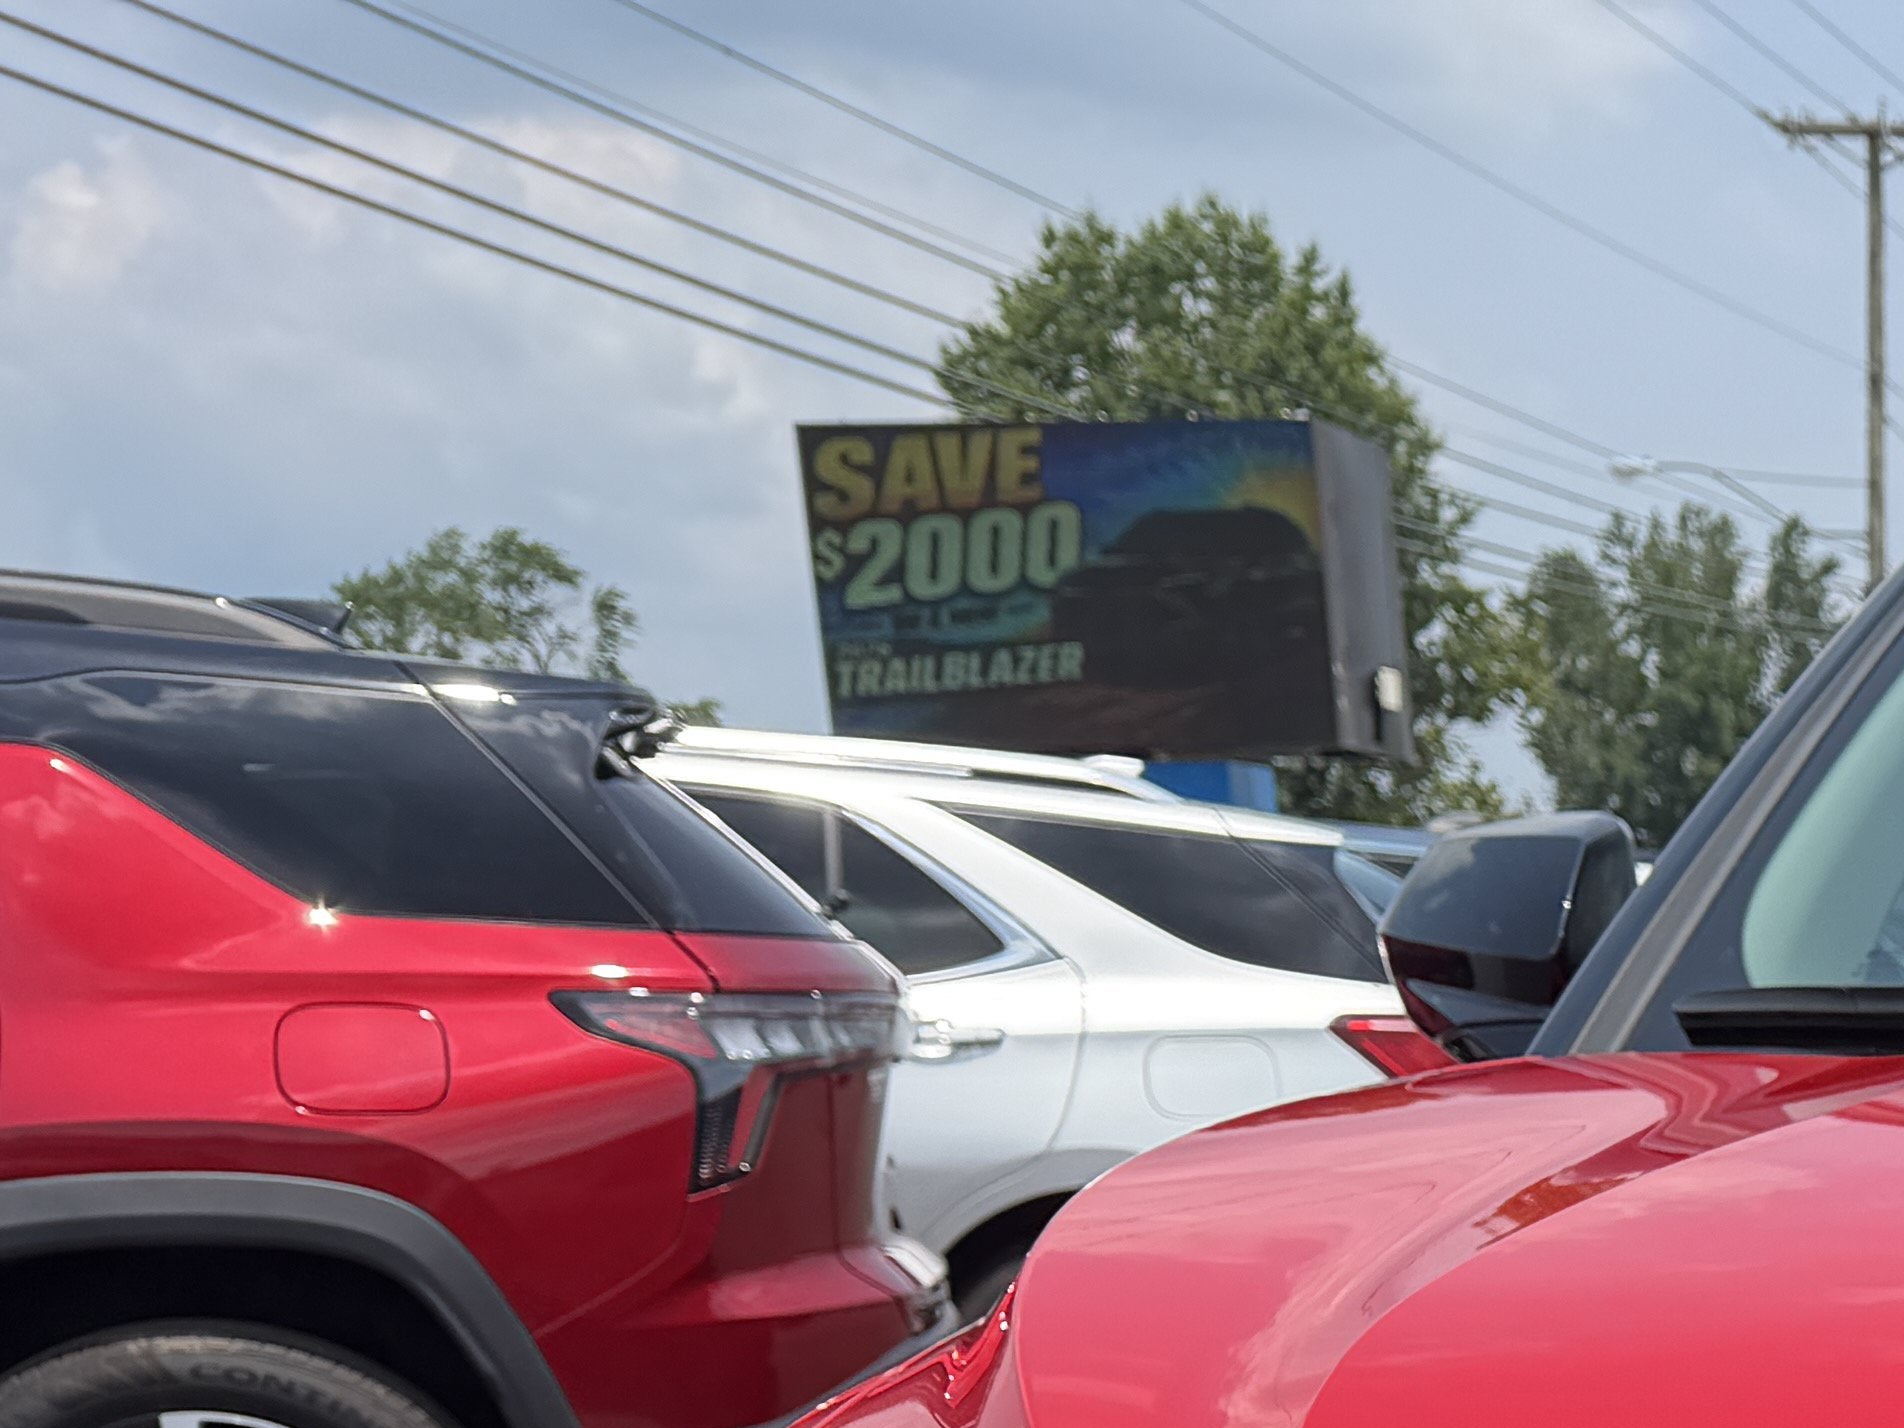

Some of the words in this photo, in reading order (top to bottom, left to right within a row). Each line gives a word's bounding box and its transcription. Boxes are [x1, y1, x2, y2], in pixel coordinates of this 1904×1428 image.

[813, 430, 1043, 520] SAVE
[815, 502, 1080, 610] $2000
[836, 642, 1084, 697] TRAILBLAZER
